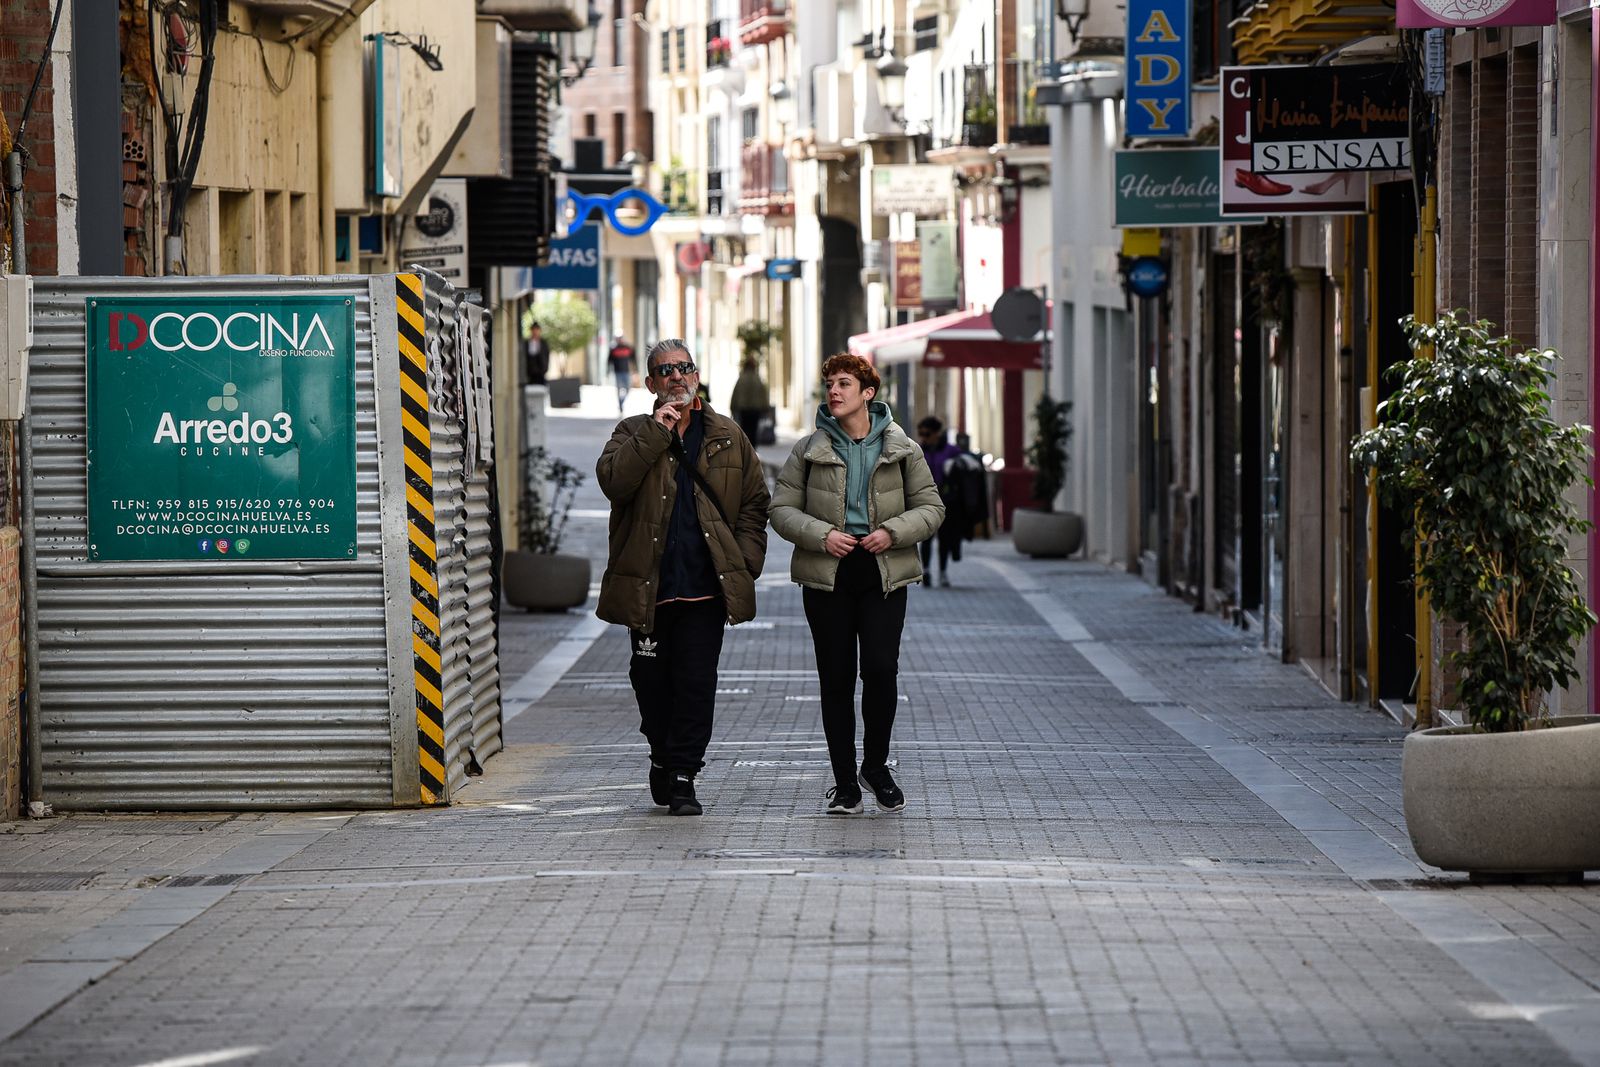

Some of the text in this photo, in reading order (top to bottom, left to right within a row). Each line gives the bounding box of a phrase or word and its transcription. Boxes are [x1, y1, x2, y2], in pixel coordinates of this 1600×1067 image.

[1262, 141, 1405, 171] SENSAI
[259, 349, 288, 357] DISEÑO
[153, 412, 293, 444] Arredo3
[180, 446, 265, 456] CUCINE
[111, 498, 335, 510] TLFN: 959 815 915/620 976 904
[136, 511, 312, 522] WWW.DCOCINAHUELVA.ES
[116, 524, 331, 535] DCOCINA@DCOCINAHUELVA.ES
